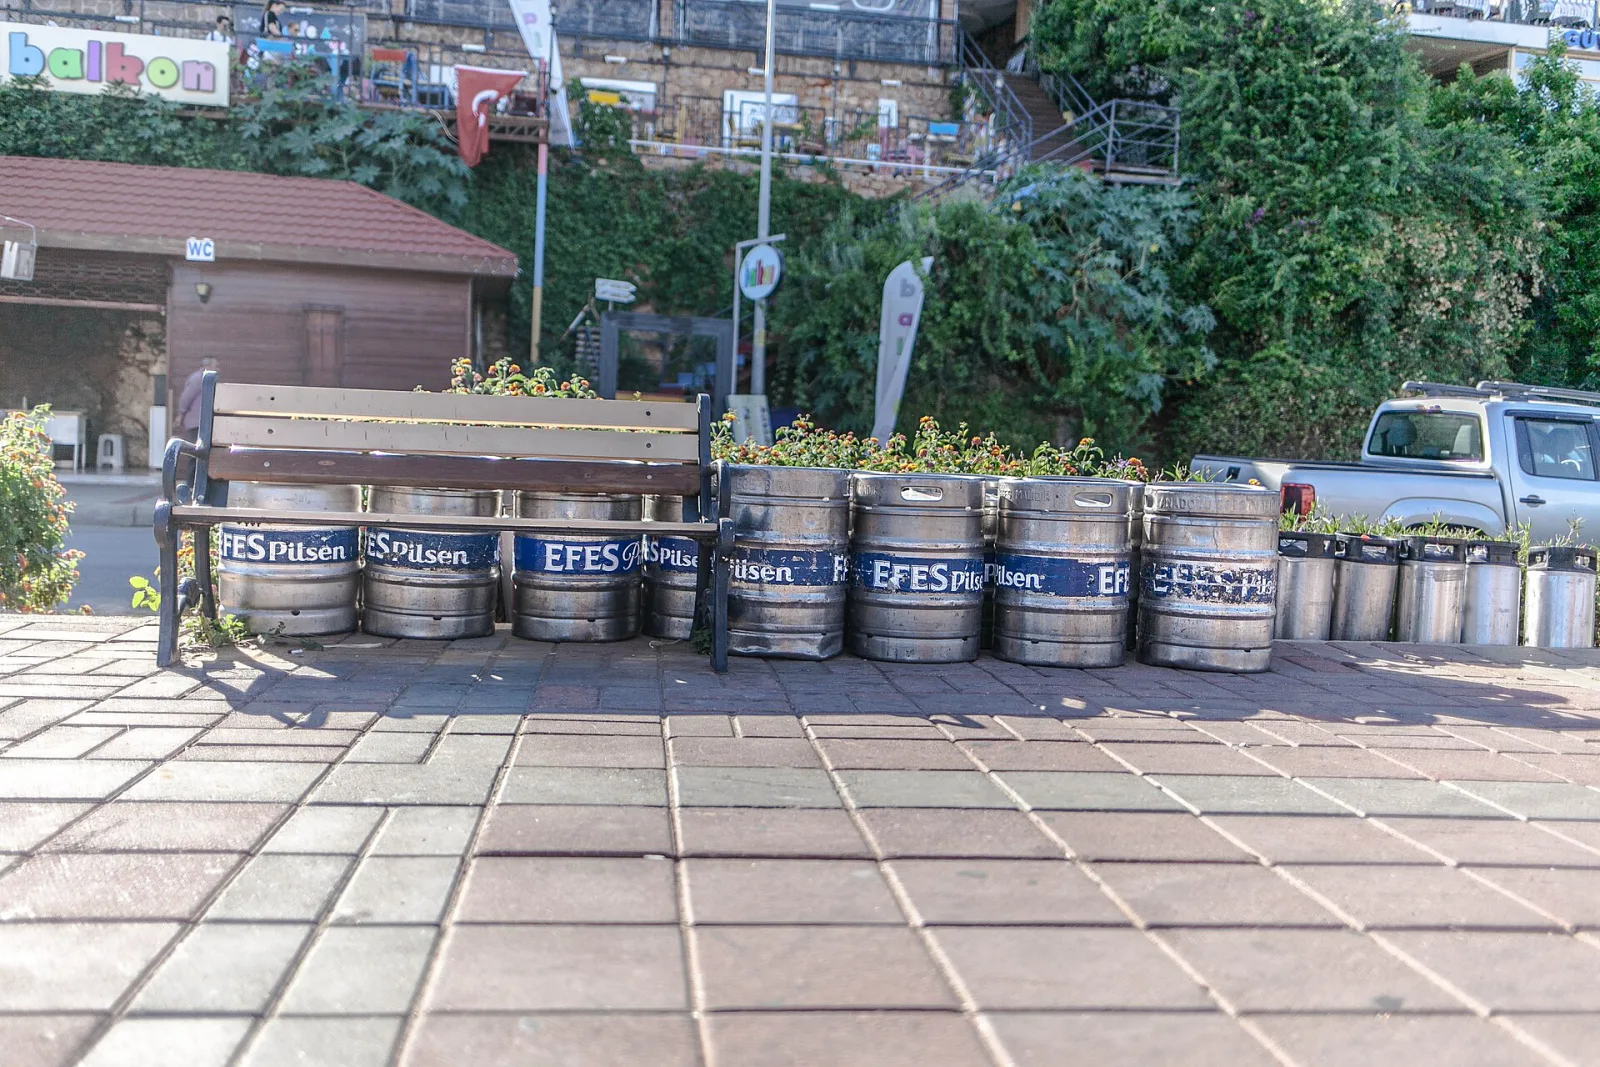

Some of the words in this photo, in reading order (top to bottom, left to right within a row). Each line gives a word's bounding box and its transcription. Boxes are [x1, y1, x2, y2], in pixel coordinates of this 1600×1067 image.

[1564, 28, 1600, 49] GÜ
[8, 31, 216, 93] balkon
[188, 242, 212, 256] WC
[219, 532, 266, 560] FES
[268, 540, 347, 562] Pilsen
[392, 541, 470, 565] Pilsen
[544, 543, 620, 572] EFES
[660, 546, 699, 567] Pilse
[873, 559, 948, 592] EFES
